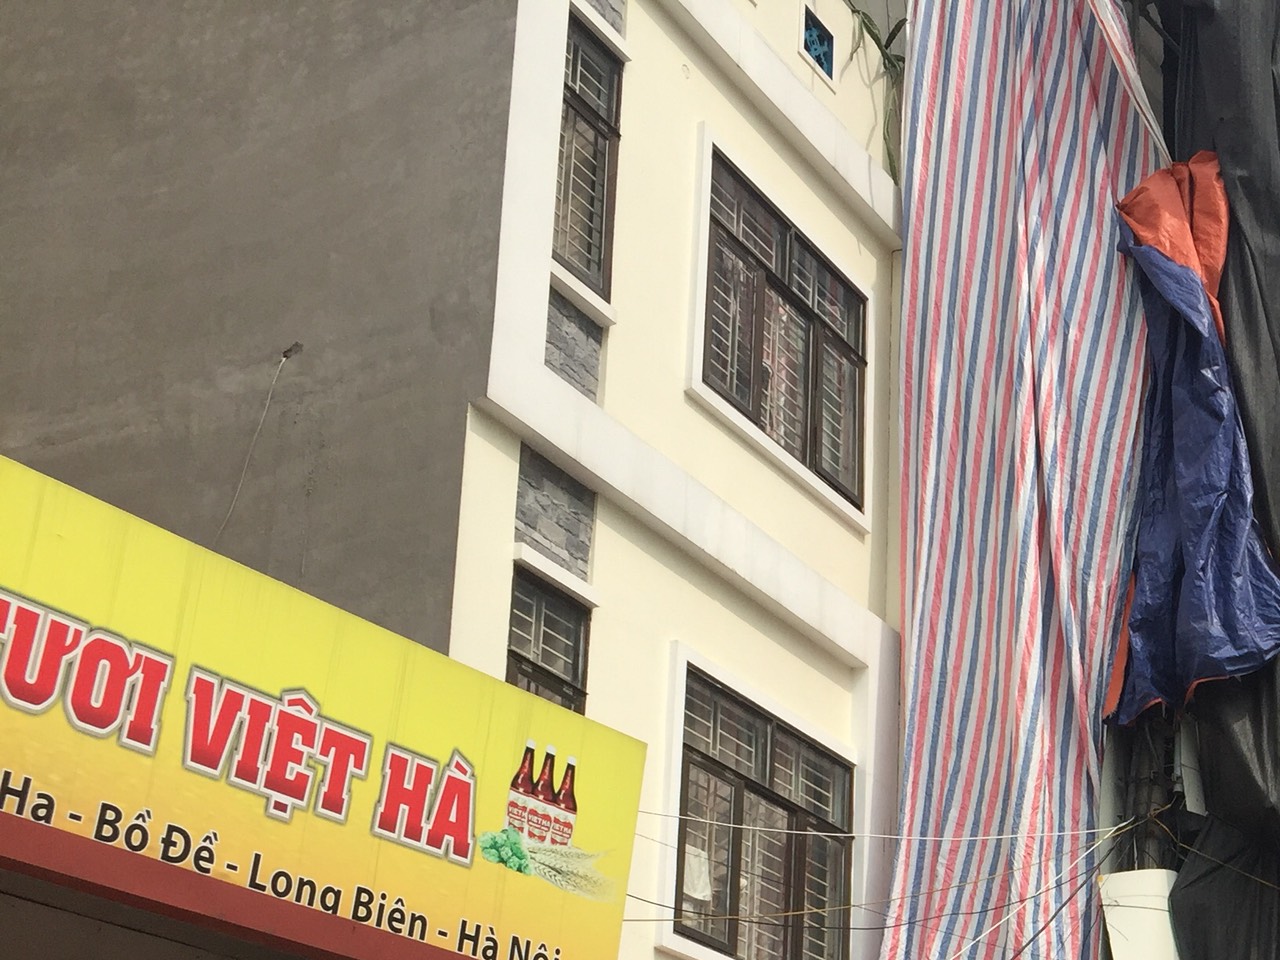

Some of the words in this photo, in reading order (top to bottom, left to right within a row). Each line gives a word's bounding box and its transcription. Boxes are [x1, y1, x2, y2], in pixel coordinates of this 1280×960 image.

[0, 594, 172, 752] ƯƠI
[187, 672, 370, 817] VIỆT
[375, 750, 474, 862] HÀ
[94, 802, 152, 852] Bồ
[160, 823, 219, 874] Đề
[248, 852, 342, 916] Long
[351, 886, 428, 941] Biên
